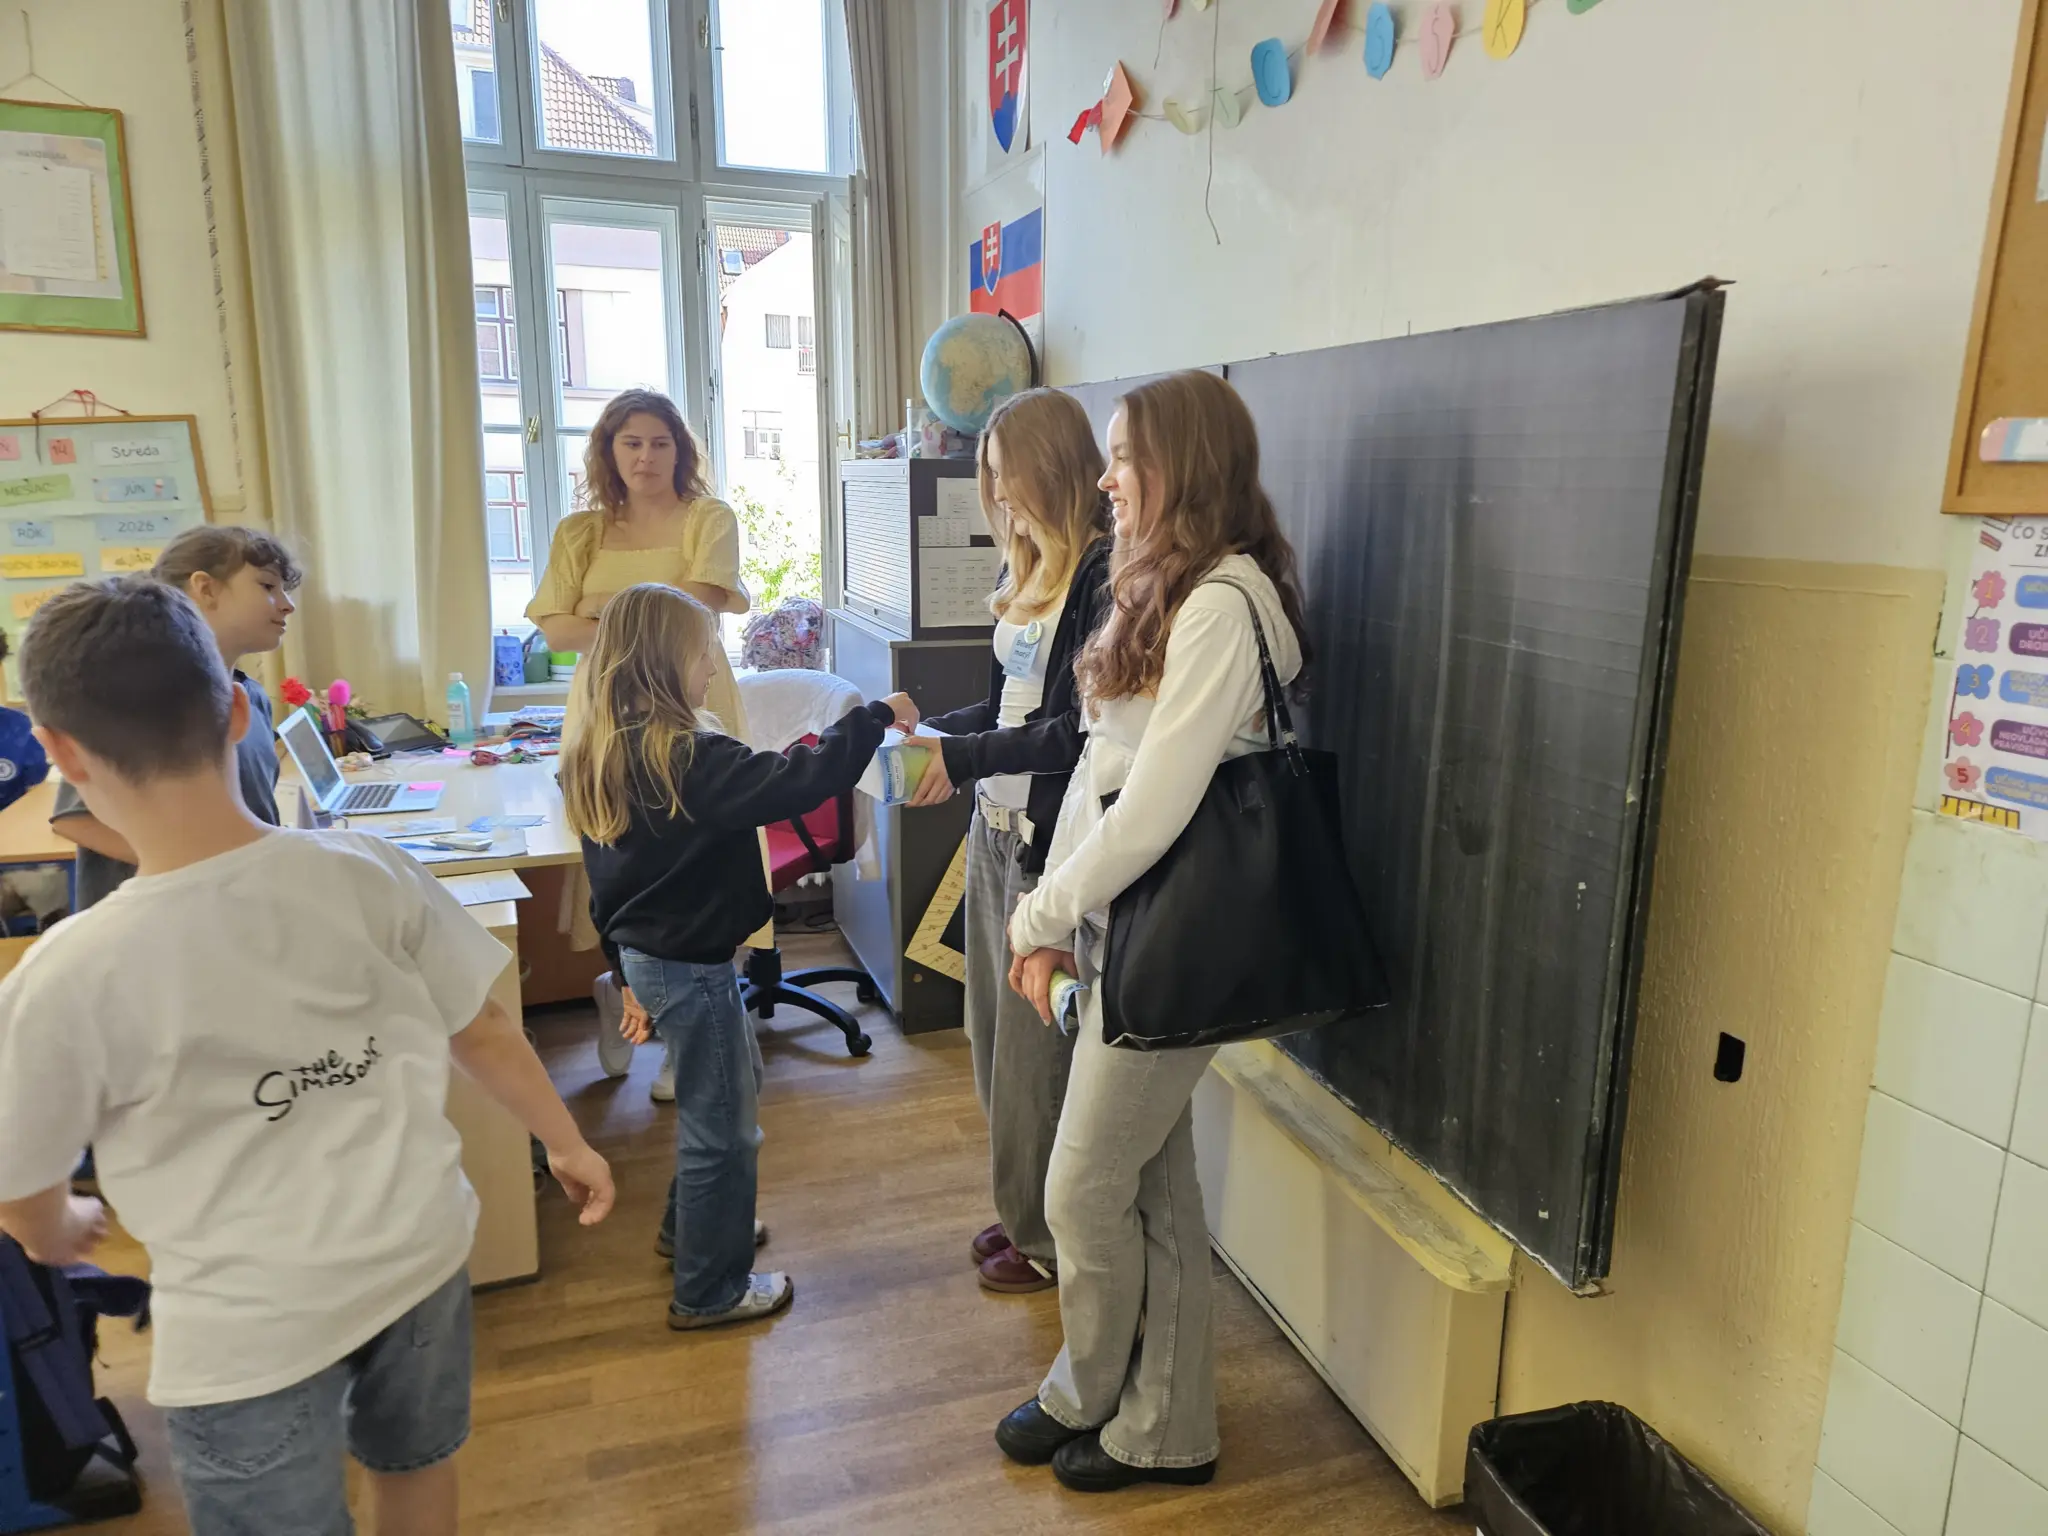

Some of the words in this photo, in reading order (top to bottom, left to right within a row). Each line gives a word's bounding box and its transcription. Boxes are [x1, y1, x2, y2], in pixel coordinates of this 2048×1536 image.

[117, 520, 156, 533] 2026
[2012, 521, 2036, 540] ČO
[1984, 578, 1995, 600] 1
[1975, 624, 1989, 645] 2
[1968, 672, 1980, 689] 3
[1960, 721, 1971, 737] 4
[1957, 767, 1969, 784] 5
